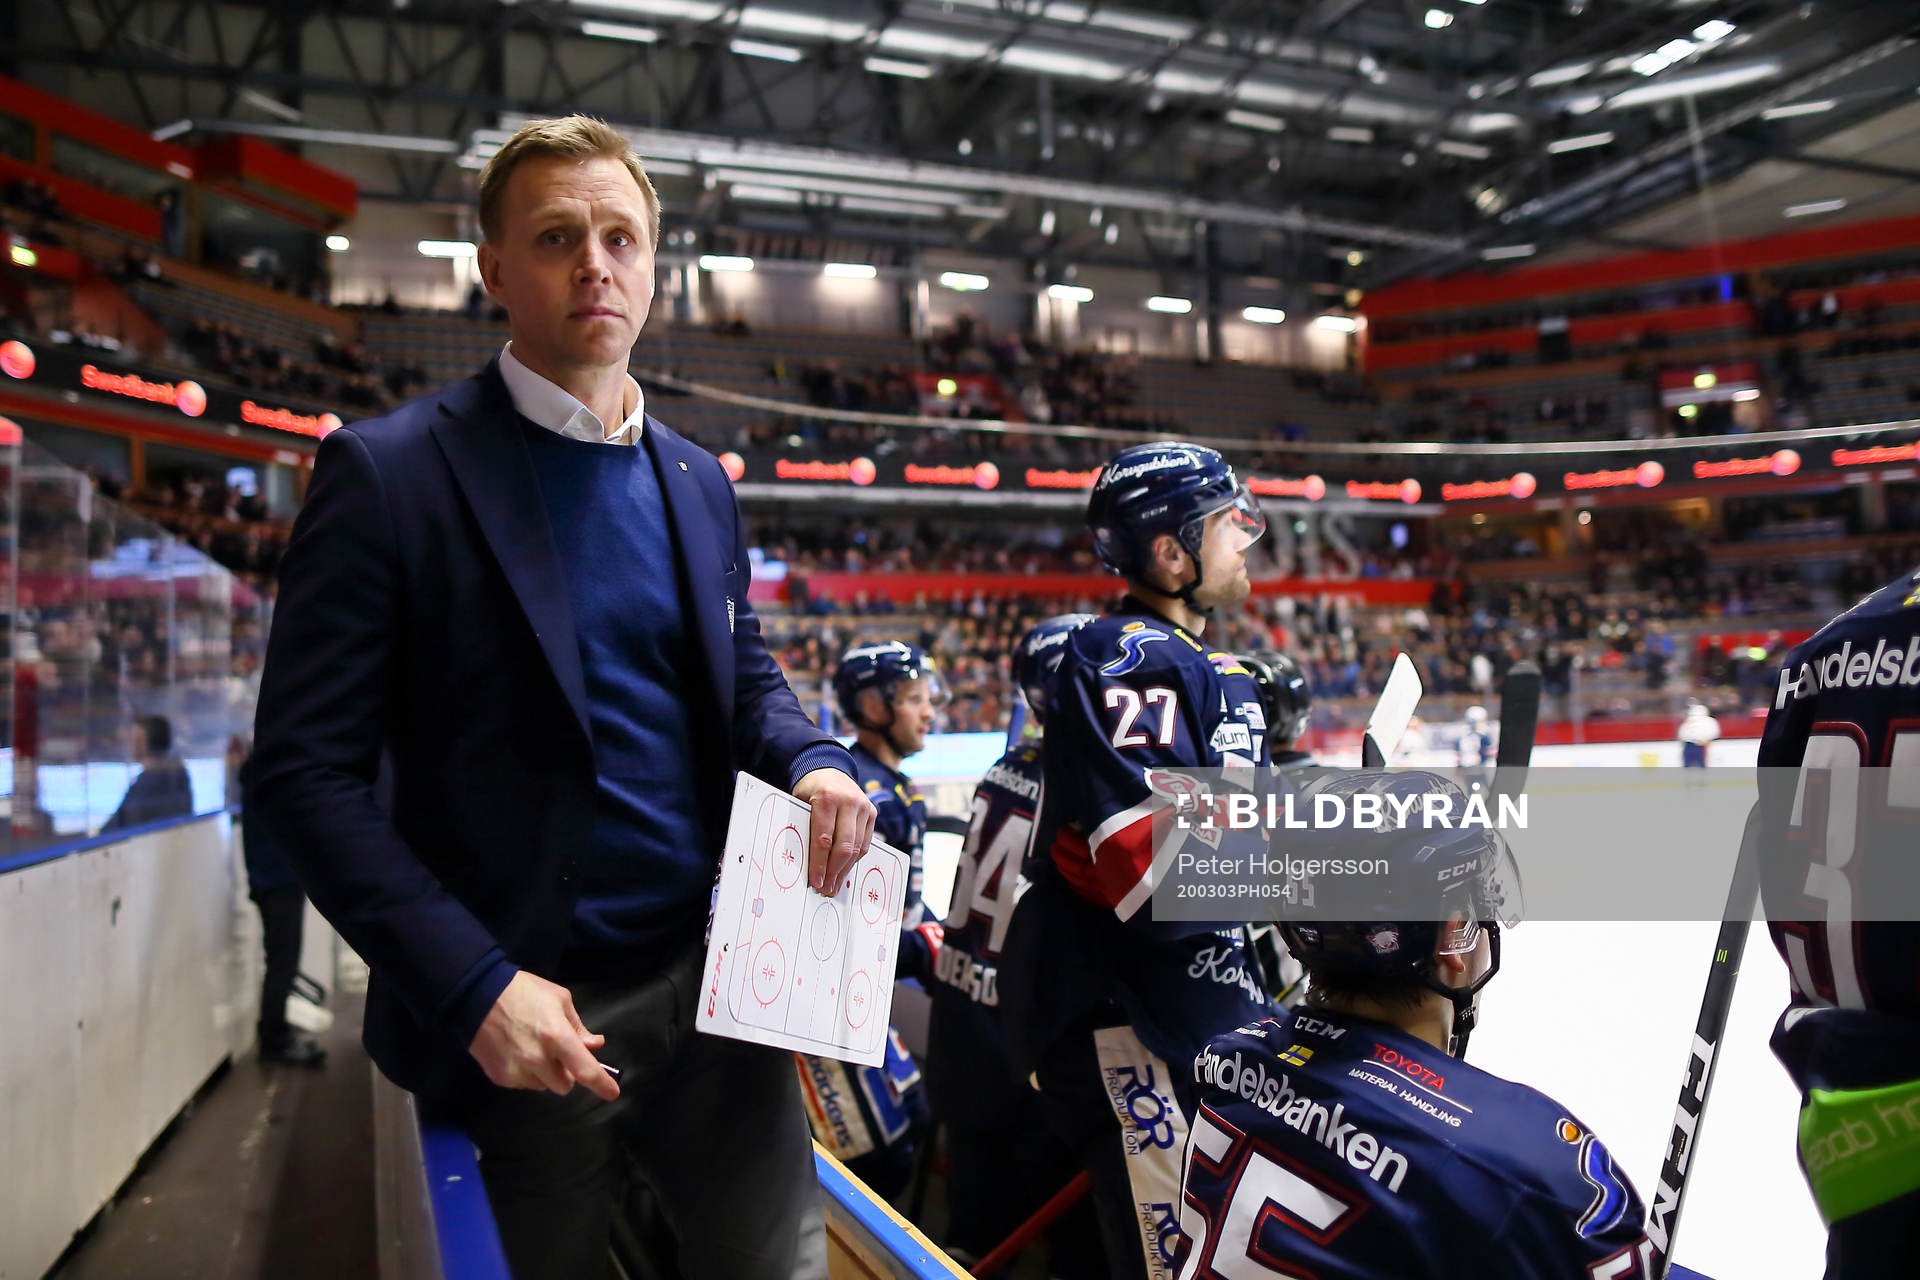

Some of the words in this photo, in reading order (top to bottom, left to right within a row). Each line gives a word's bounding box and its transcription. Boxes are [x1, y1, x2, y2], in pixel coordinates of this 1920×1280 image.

[1105, 687, 1179, 749] 27
[1437, 859, 1477, 882] CCM
[707, 951, 724, 1019] CCM
[1295, 1016, 1347, 1040] CCM
[1348, 1067, 1398, 1095] MATERIAL
[1398, 1089, 1463, 1128] HANDLING
[1373, 1043, 1446, 1092] TOYOTA
[1104, 1067, 1141, 1157] PRODUKTION
[1194, 1044, 1409, 1194] Handelsbanken
